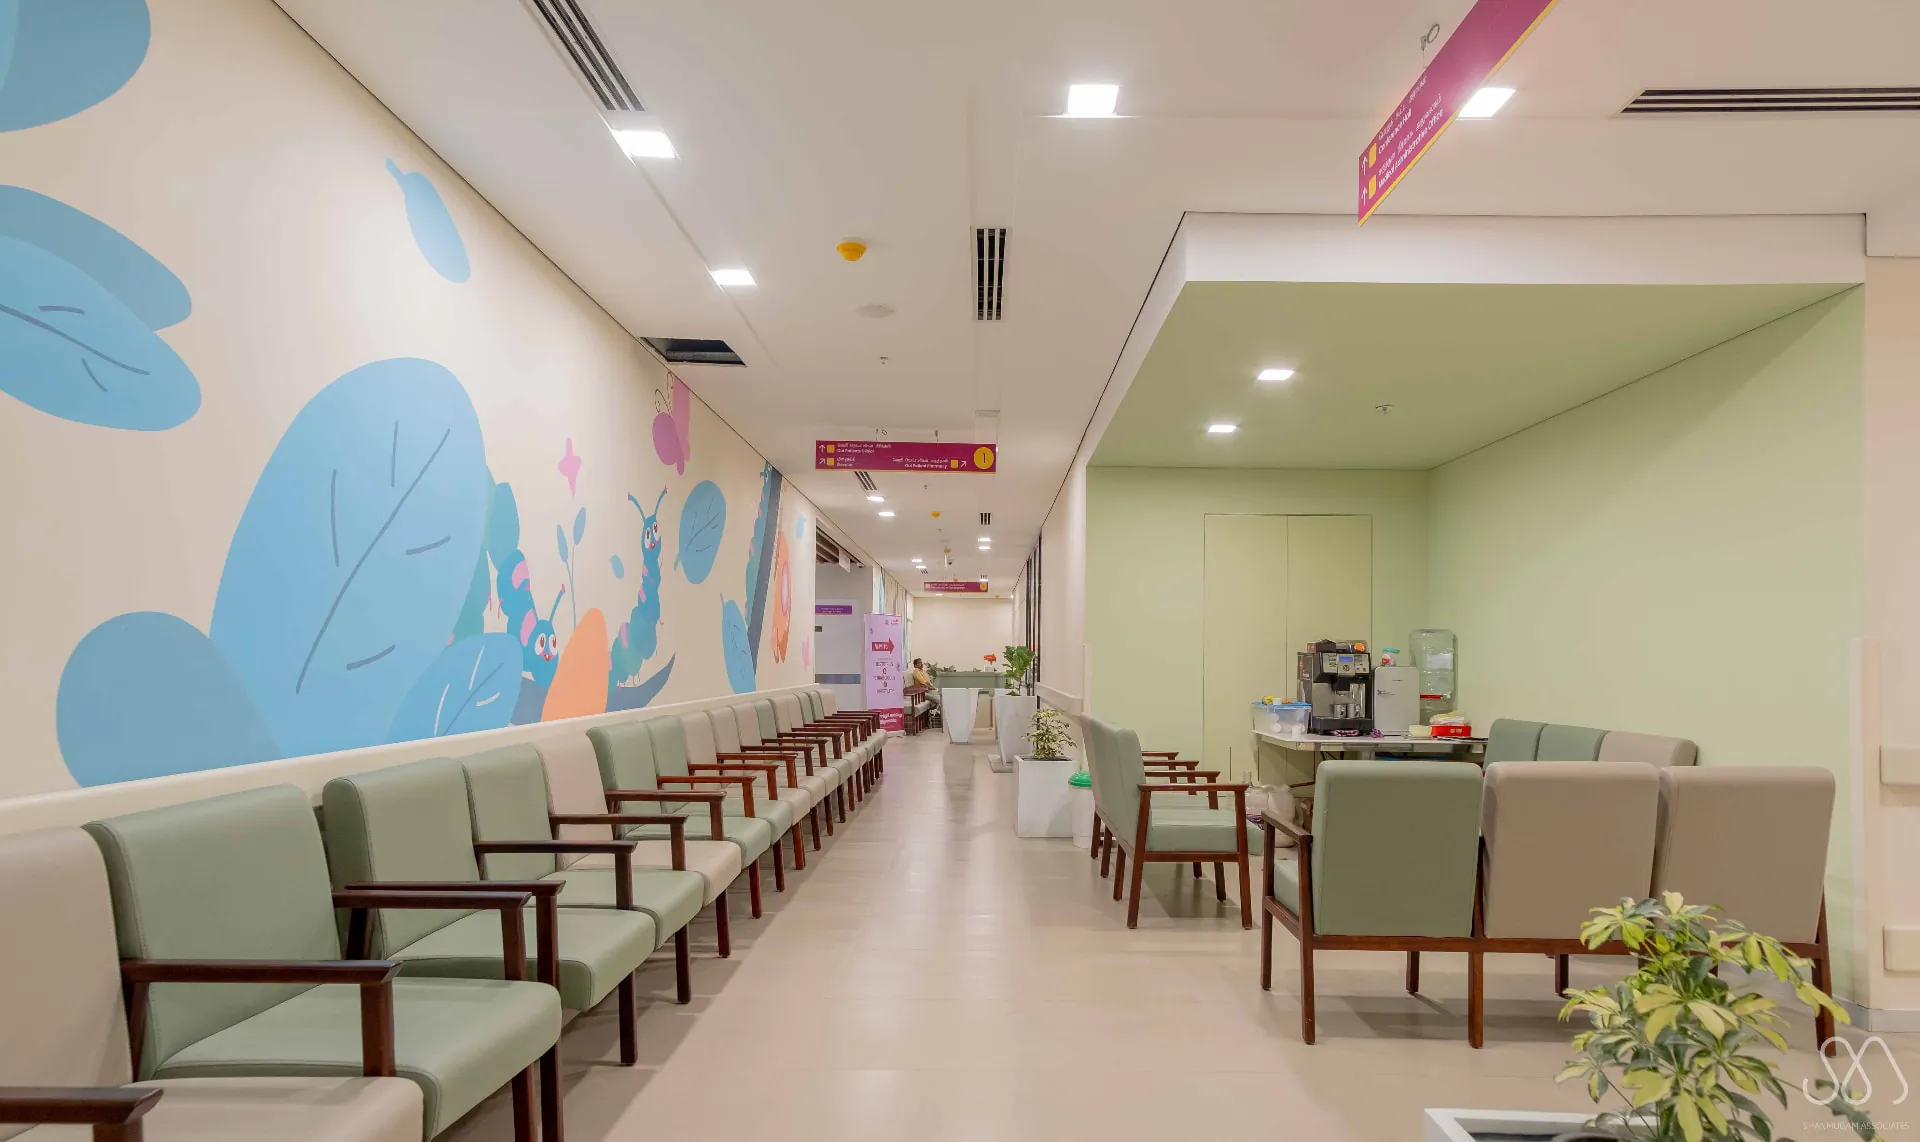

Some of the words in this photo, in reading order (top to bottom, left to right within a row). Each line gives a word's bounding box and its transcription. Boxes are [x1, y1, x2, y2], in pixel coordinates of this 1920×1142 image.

[1378, 164, 1395, 189] Medical
[1395, 127, 1428, 170] Administrative
[1427, 108, 1444, 131] Office
[1379, 120, 1404, 154] Conference
[1402, 108, 1412, 127] Hall
